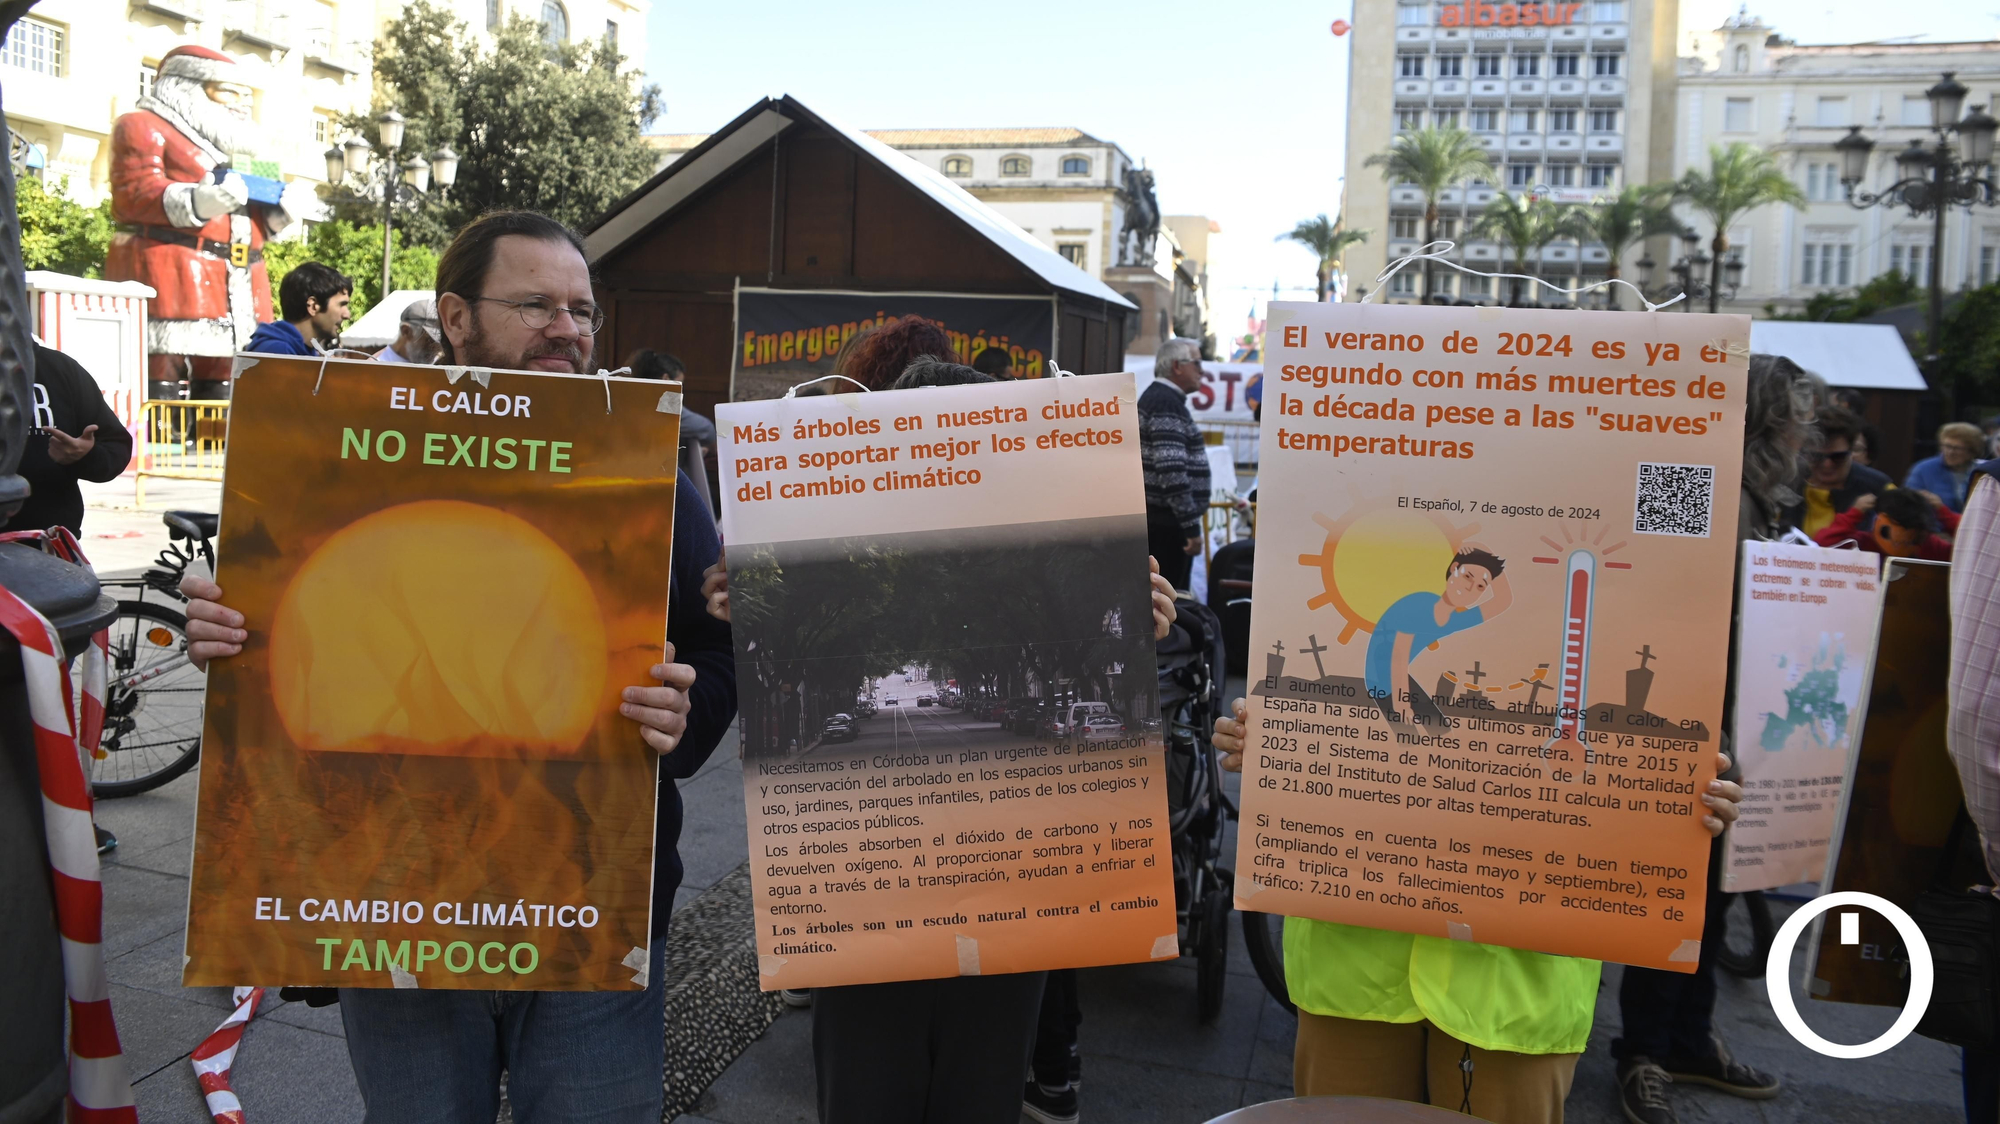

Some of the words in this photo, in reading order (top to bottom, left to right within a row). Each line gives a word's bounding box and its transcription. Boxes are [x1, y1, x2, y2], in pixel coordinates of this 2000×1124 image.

[1441, 0, 1582, 27] albasur
[1283, 325, 1308, 348] El
[1325, 332, 1425, 353] verano
[1442, 330, 1479, 355] de
[1497, 332, 1574, 358] 2024
[1591, 340, 1627, 360] es
[1644, 342, 1681, 367] ya
[1700, 339, 1728, 363] el
[1281, 362, 1403, 389] segundo
[1412, 369, 1464, 389] con
[1476, 365, 1538, 392] más
[1548, 373, 1677, 398] muertes
[1687, 374, 1727, 400] de
[390, 387, 424, 411] EL
[432, 390, 531, 418] CALOR
[733, 421, 781, 445] Más
[793, 416, 882, 440] árboles
[893, 415, 923, 432] en
[936, 405, 1029, 429] nuestra
[1041, 395, 1121, 421] ciudad
[1280, 392, 1304, 416] la
[1313, 393, 1416, 422] década
[1426, 404, 1495, 428] pese
[1504, 408, 1522, 427] a
[1532, 403, 1575, 430] las
[1586, 405, 1724, 436] "suaves"
[341, 427, 407, 463] NO
[423, 433, 573, 473] EXISTE
[735, 455, 788, 478] para
[798, 444, 901, 472] soportar
[910, 436, 982, 462] mejor
[991, 433, 1027, 454] los
[1036, 427, 1124, 450] efectos
[1277, 427, 1475, 460] temperaturas
[737, 480, 773, 503] del
[780, 474, 866, 500] cambio
[872, 466, 982, 492] climático
[1398, 496, 1408, 508] El
[1413, 497, 1464, 514] Español,
[1470, 501, 1478, 512] 7
[1481, 502, 1497, 514] de
[1501, 505, 1544, 518] agosto
[1548, 506, 1564, 518] de
[1568, 507, 1600, 520] 2024
[1753, 555, 1768, 566] Los
[1773, 557, 1816, 570] fenómenos
[1753, 573, 1792, 585] extremos
[1801, 577, 1811, 586] se
[1820, 578, 1847, 589] cobran
[1752, 589, 1787, 601] también
[1790, 592, 1798, 602] en
[1801, 591, 1827, 605] Europa
[759, 761, 844, 776] Necesitamos
[850, 760, 866, 770] en
[872, 753, 930, 768] Córdoba
[936, 754, 953, 764] un
[960, 750, 988, 766] plan
[994, 745, 1048, 762] urgente
[1054, 738, 1070, 756] de
[1077, 735, 1146, 756] plantación
[1261, 735, 1298, 752] 2023
[1307, 741, 1320, 755] el
[1329, 743, 1389, 762] Sistema
[1399, 750, 1418, 766] de
[1428, 754, 1542, 779] Monitorización
[1552, 767, 1572, 783] de
[1583, 770, 1596, 786] la
[1608, 773, 1695, 794] Mortalidad
[1262, 718, 1359, 739] ampliamente
[1367, 726, 1388, 742] las
[1396, 732, 1460, 750] muertes
[1468, 740, 1488, 752] en
[1496, 743, 1574, 762] carretera.
[1584, 749, 1628, 768] Entre
[1637, 755, 1678, 772] 2015
[1687, 762, 1698, 777] y
[760, 786, 768, 798] y
[774, 776, 861, 795] conservación
[866, 775, 887, 789] del
[892, 771, 952, 788] arbolado
[957, 772, 974, 783] en
[980, 768, 1000, 781] los
[1004, 764, 1063, 781] espacios
[1068, 760, 1124, 774] urbanos
[1128, 755, 1147, 768] sin
[1260, 755, 1302, 773] Diaria
[1308, 761, 1331, 776] del
[1337, 764, 1401, 784] Instituto
[1407, 772, 1426, 787] de
[1432, 775, 1476, 793] Salud
[1482, 780, 1532, 799] Carlos
[1538, 786, 1559, 802] III
[1565, 791, 1620, 809] calcula
[1628, 800, 1648, 812] un
[1655, 800, 1693, 816] total
[763, 822, 798, 835] otros
[802, 818, 860, 835] espacios
[864, 814, 924, 832] públicos.
[766, 862, 835, 877] devuelven
[845, 857, 902, 874] oxígeno.
[913, 854, 926, 868] Al
[936, 850, 1023, 869] proporcionar
[1032, 843, 1083, 858] sombra
[1093, 843, 1101, 856] y
[1111, 838, 1154, 851] liberar
[1252, 872, 1303, 892] tráfico:
[1310, 880, 1351, 898] 7.210
[1356, 890, 1374, 902] en
[1380, 892, 1416, 908] ocho
[1422, 896, 1462, 914] años.
[1254, 853, 1285, 869] cifra
[1299, 859, 1348, 878] triplica
[1362, 867, 1384, 883] los
[1398, 872, 1504, 899] fallecimientos
[1519, 891, 1546, 905] por
[1560, 896, 1647, 917] accidentes
[1663, 906, 1684, 922] de
[255, 897, 290, 921] EL
[299, 898, 424, 924] CAMBIO
[433, 899, 600, 928] CLIMÁTICO
[770, 903, 826, 916] entorno.
[772, 925, 796, 936] Los
[806, 921, 854, 934] árboles
[863, 922, 886, 931] son
[896, 919, 913, 929] un
[923, 912, 968, 927] escudo
[978, 907, 1026, 922] natural
[1036, 906, 1079, 918] contra
[1089, 900, 1100, 913] el
[1110, 896, 1158, 911] cambio
[315, 938, 540, 975] TAMPOCO
[773, 941, 836, 955] climático.
